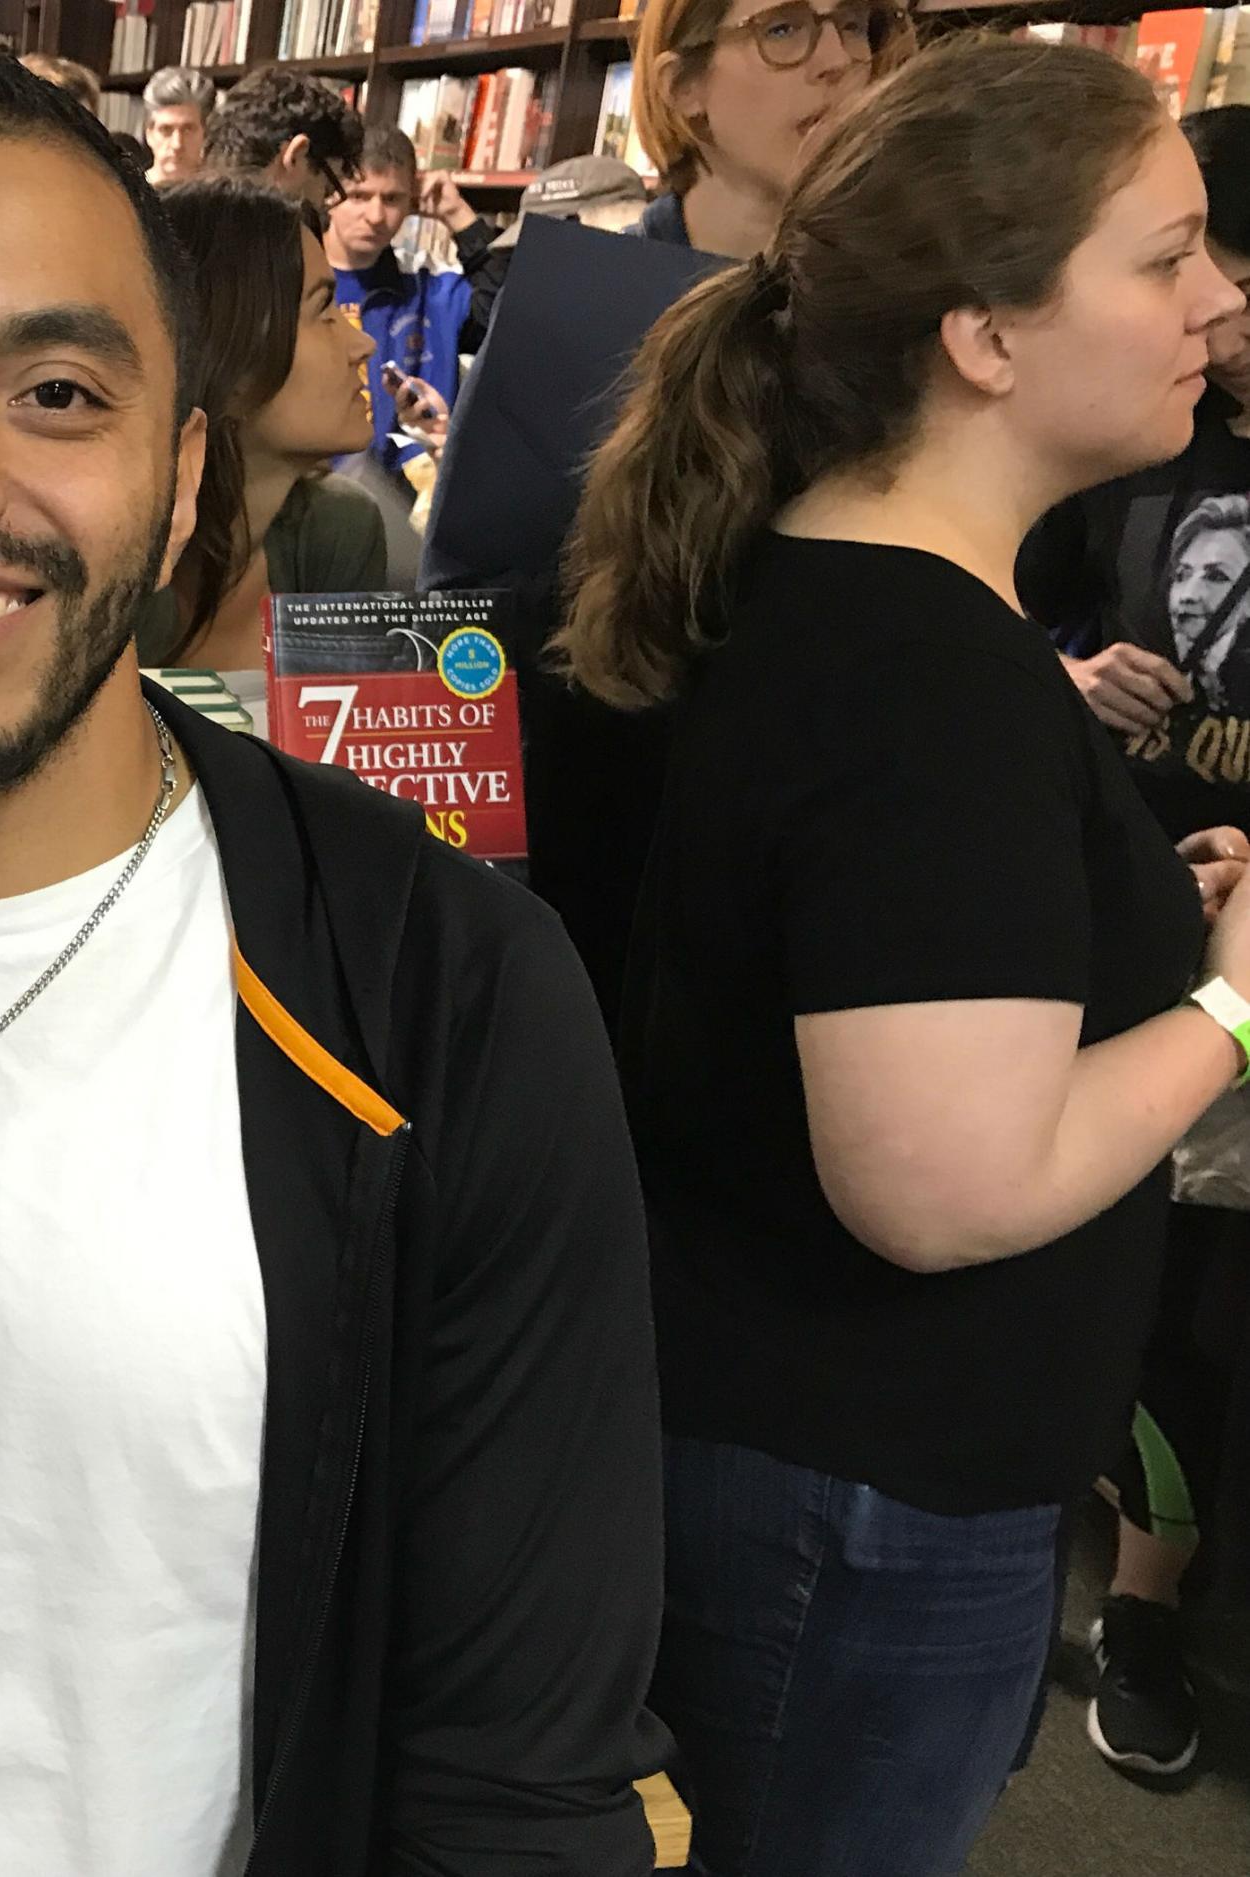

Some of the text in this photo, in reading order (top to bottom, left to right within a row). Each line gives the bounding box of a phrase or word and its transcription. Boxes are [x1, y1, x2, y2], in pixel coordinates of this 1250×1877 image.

[287, 600, 493, 613] THE INTERNATIONAL BESTSELLER
[293, 612, 488, 626] UPDATED FOR THE DIGITAL AGE
[446, 636, 470, 658] MORE
[298, 685, 496, 763] THE 7 HABITS OF
[346, 742, 467, 770] HIGHLY
